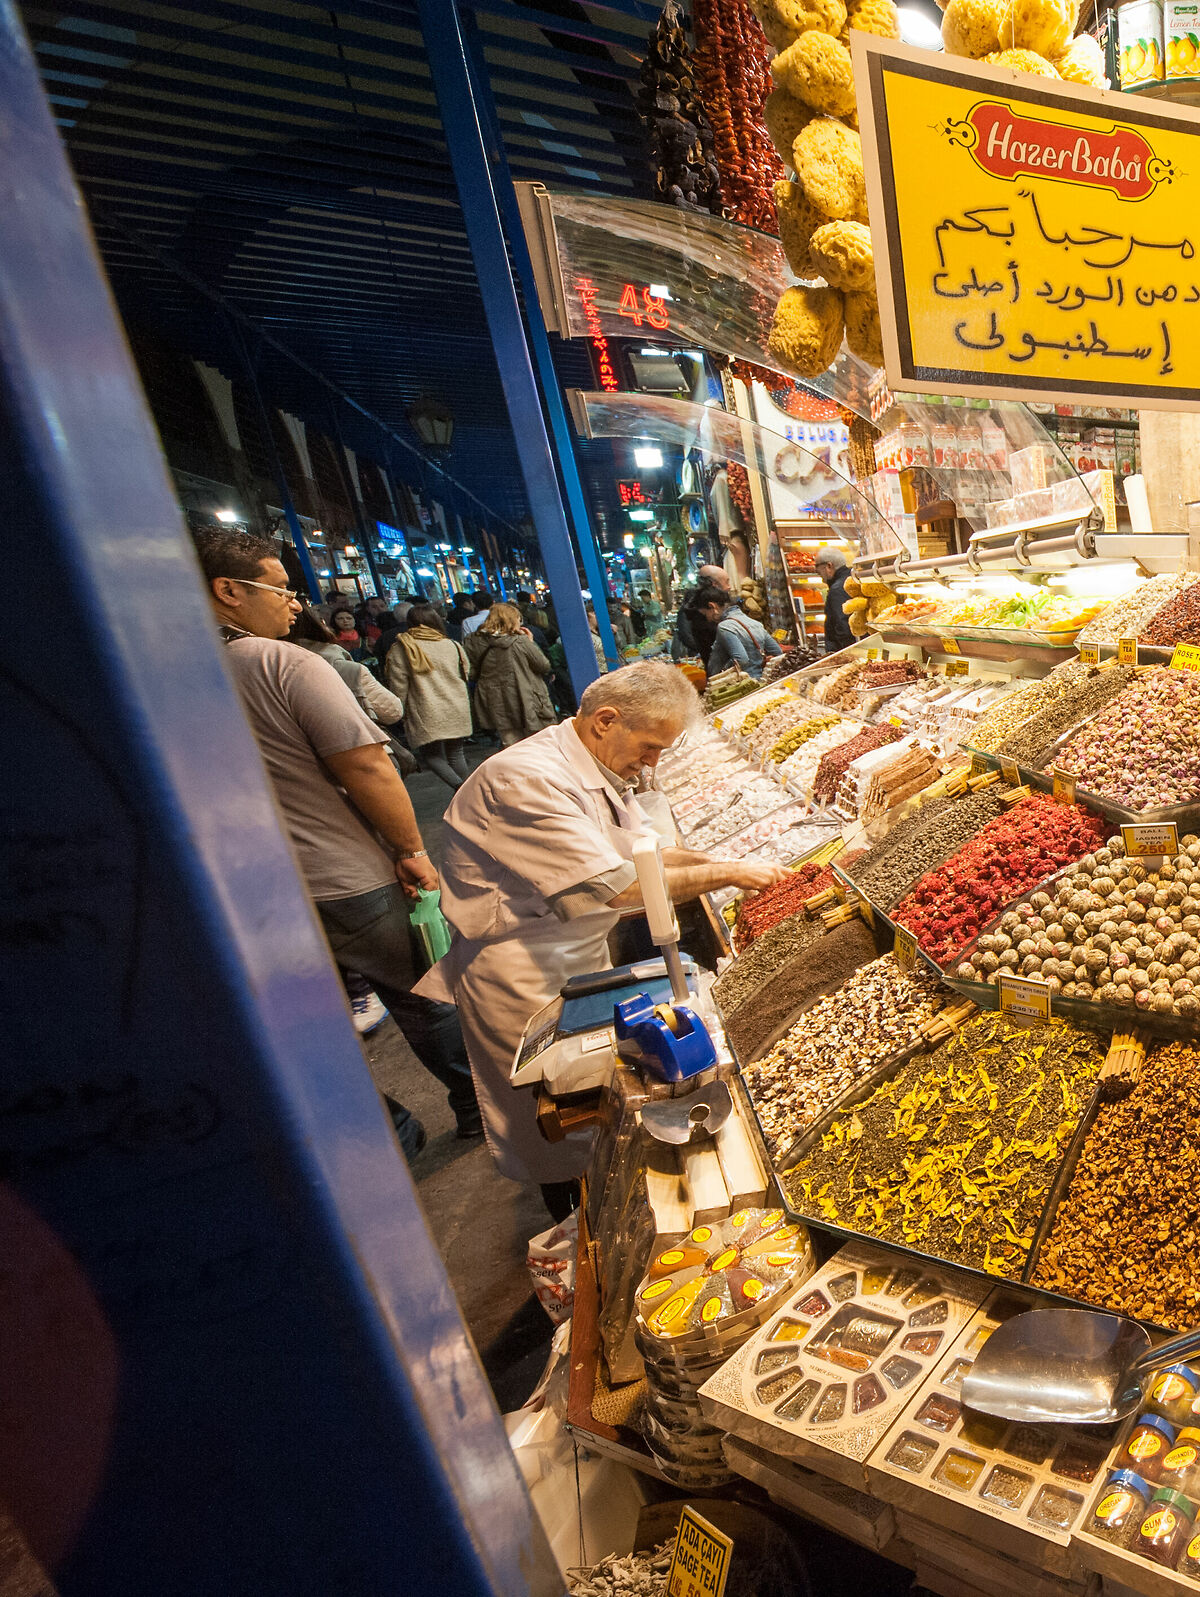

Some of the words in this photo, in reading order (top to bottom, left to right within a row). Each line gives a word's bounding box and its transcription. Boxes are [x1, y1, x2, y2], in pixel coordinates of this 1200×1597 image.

[1170, 19, 1191, 28] Lemon
[986, 121, 1142, 183] HazerBaba
[934, 207, 1016, 268] بكم
[618, 284, 671, 330] 48
[1036, 276, 1124, 310] الورد
[1177, 650, 1193, 659] ROSE
[1181, 661, 1198, 672] 140
[1138, 845, 1167, 854] 250
[1144, 1514, 1173, 1531] SUMC
[683, 1524, 700, 1552] ADA
[700, 1538, 722, 1569] ÇAYI
[677, 1546, 699, 1579] SAGE
[700, 1564, 716, 1595] TEA
